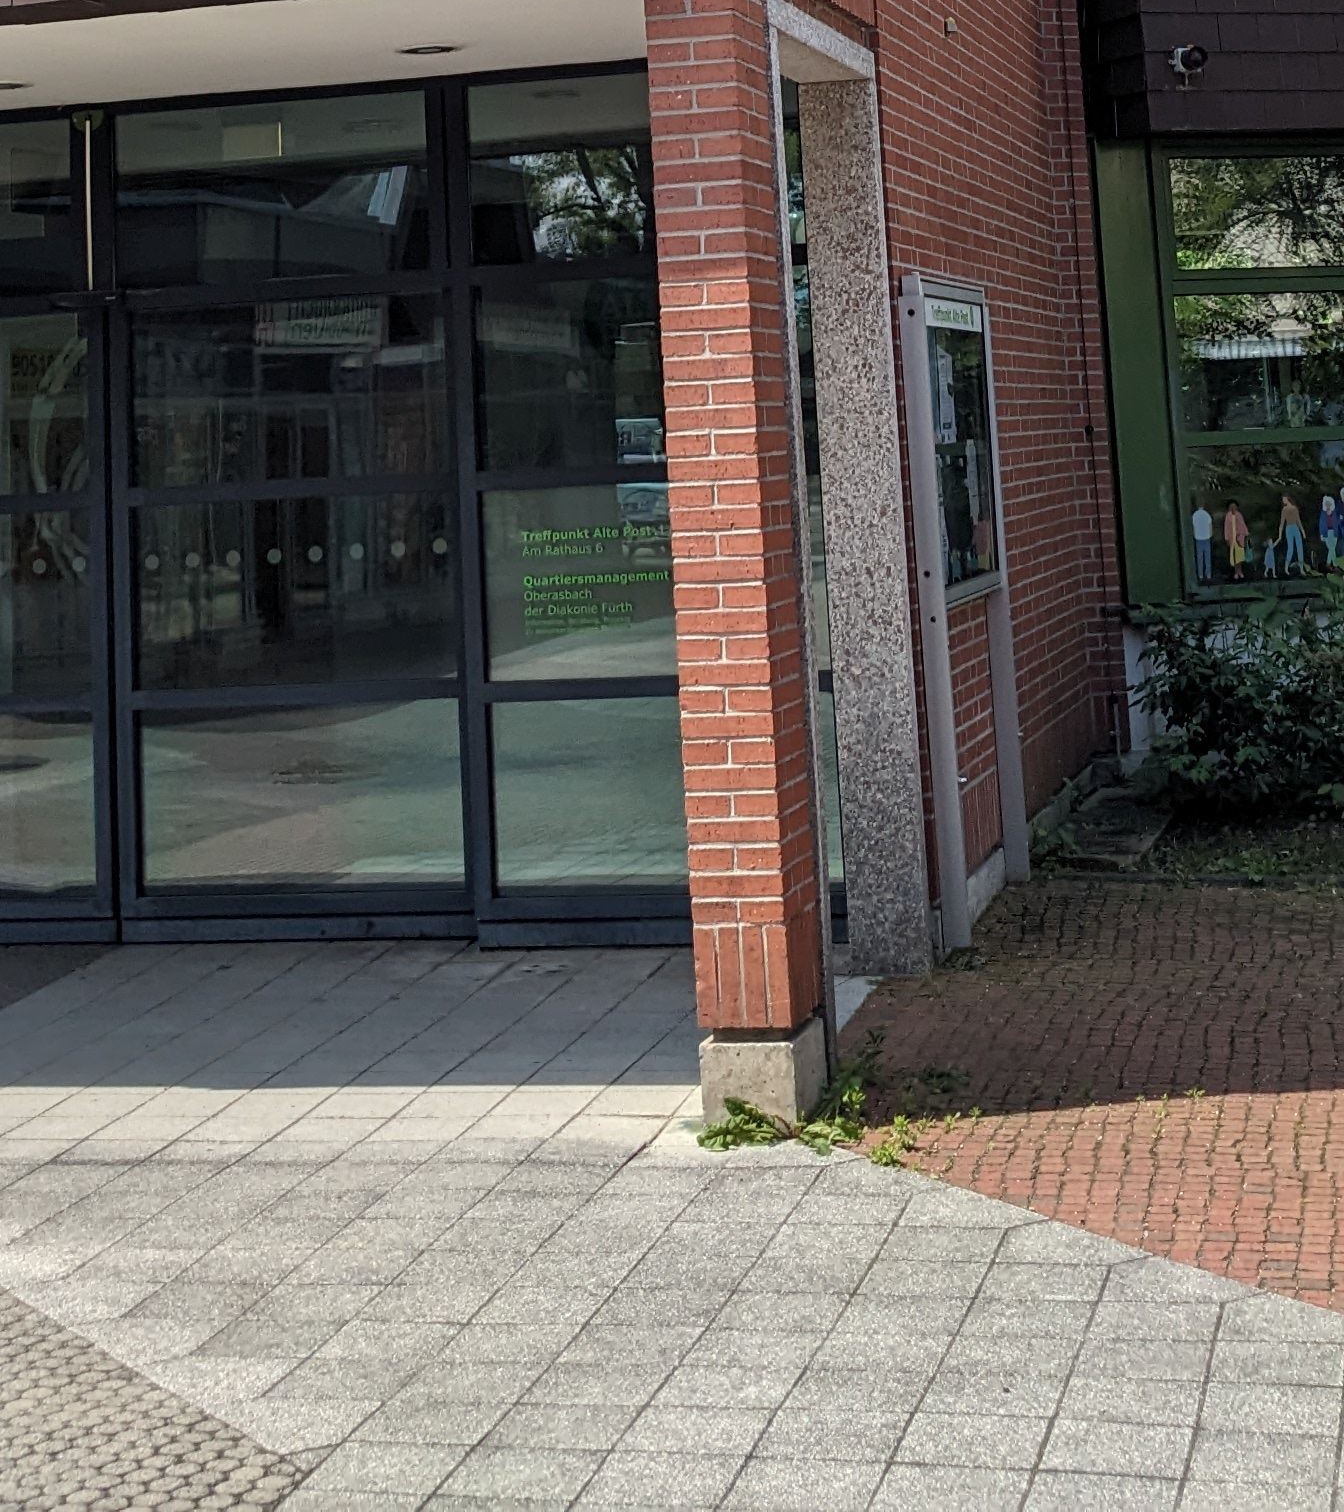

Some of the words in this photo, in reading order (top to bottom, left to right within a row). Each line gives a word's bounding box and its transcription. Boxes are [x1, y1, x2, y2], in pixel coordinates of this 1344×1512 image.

[521, 528, 590, 542] Treffpunkt
[592, 526, 619, 539] Alte
[622, 524, 652, 538] Post
[522, 545, 541, 558] Am
[545, 543, 592, 557] Rathaus
[595, 542, 604, 553] 6
[523, 570, 670, 588] Quartiersmanagement
[523, 589, 593, 602] Oberasbach
[524, 604, 544, 617] der
[547, 603, 598, 615] Diakonie
